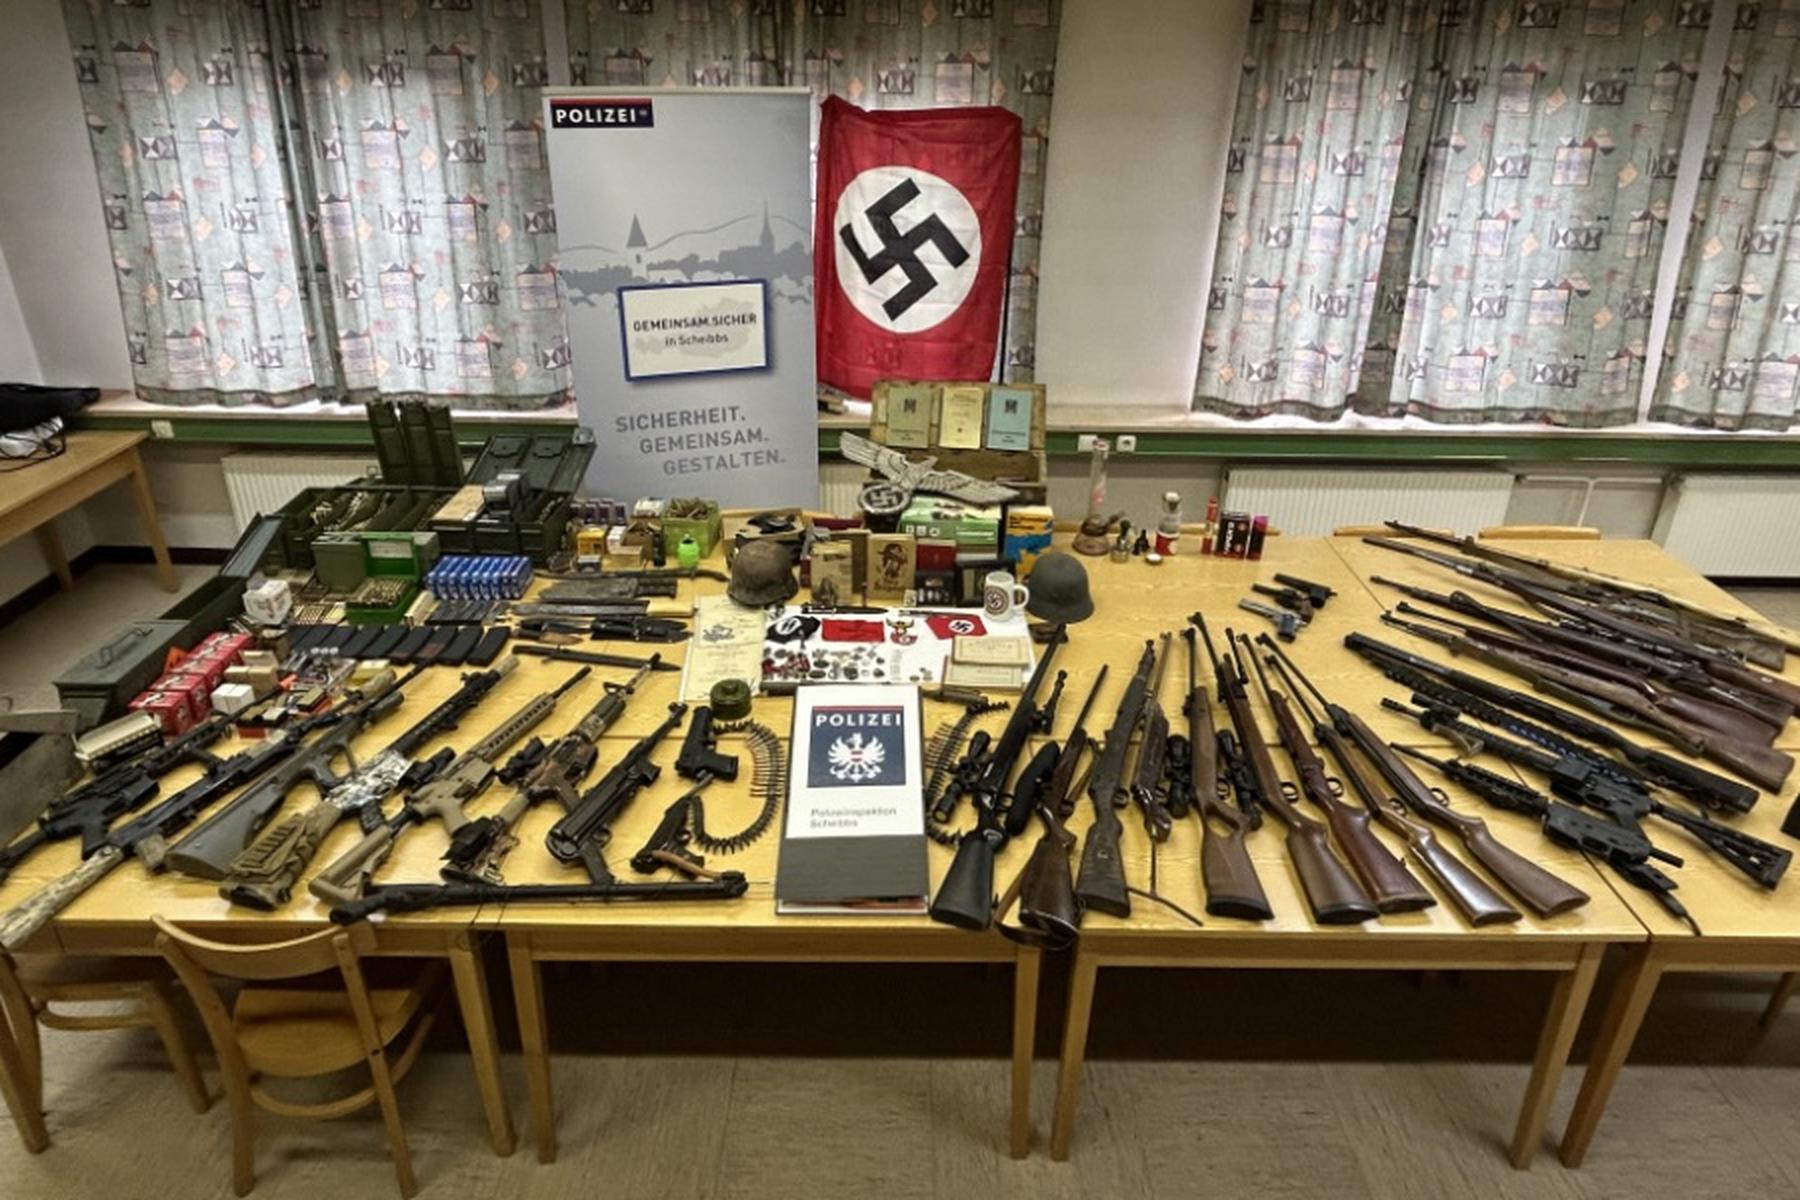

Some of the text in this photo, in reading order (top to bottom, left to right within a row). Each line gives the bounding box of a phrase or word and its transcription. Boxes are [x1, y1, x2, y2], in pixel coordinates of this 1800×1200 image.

[555, 108, 636, 123] POLIZEI
[665, 333, 729, 347] in Scheibbs
[615, 405, 746, 432] SICHERHEIT.
[639, 428, 769, 454] GEMEINSAM.
[664, 450, 786, 475] GESTALTEN.
[816, 713, 901, 727] POLIZEI
